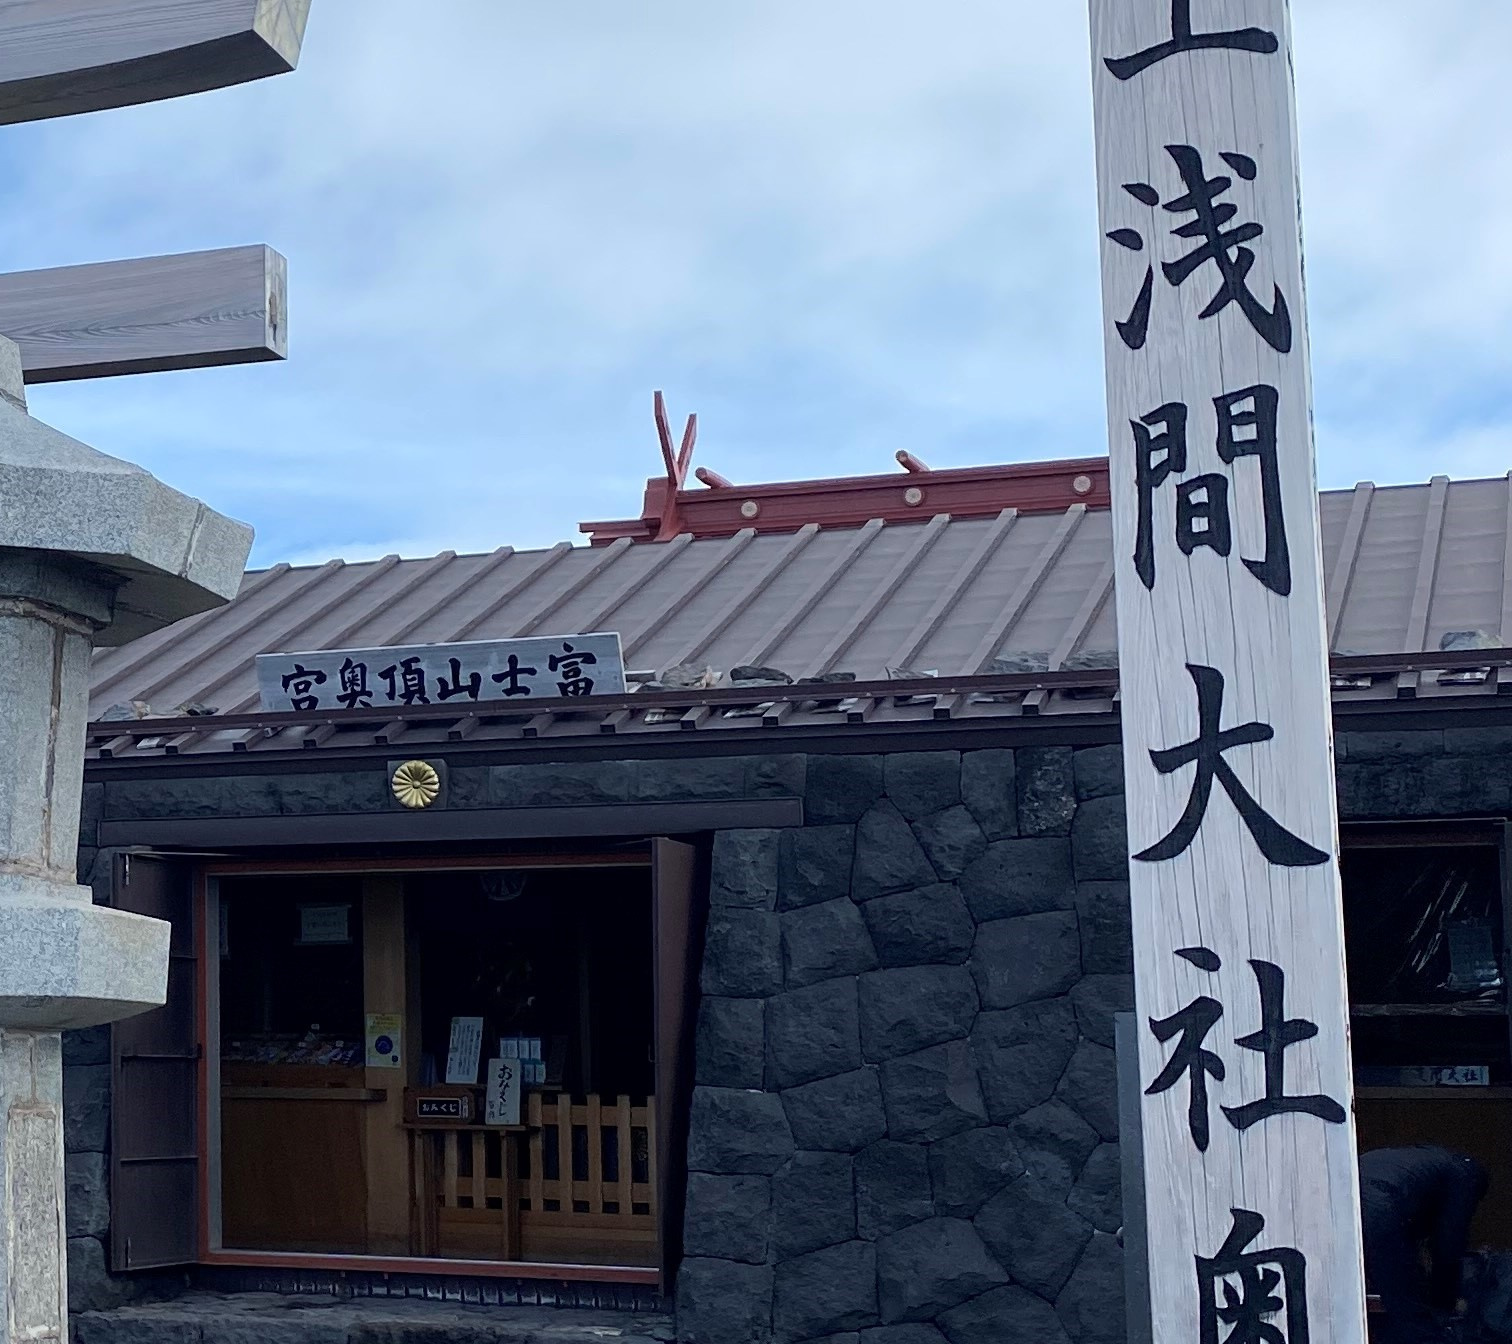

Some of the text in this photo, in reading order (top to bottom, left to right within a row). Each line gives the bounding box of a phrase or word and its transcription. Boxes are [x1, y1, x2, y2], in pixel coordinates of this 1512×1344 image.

[281, 641, 597, 712] 富士山頂奥宮
